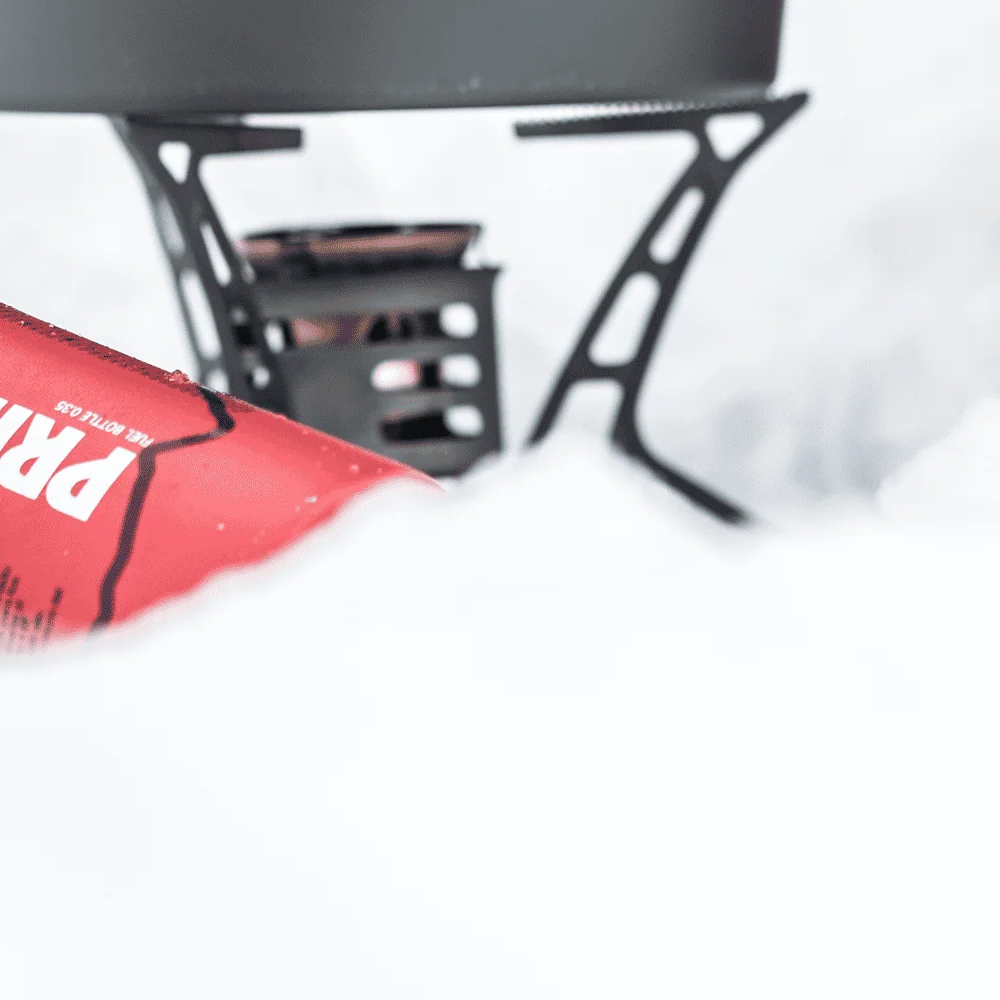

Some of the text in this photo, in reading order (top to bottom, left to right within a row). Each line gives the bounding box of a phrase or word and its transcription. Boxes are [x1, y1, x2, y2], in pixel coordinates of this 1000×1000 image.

[54, 400, 154, 448] FUEL BOTTLE 0.35
